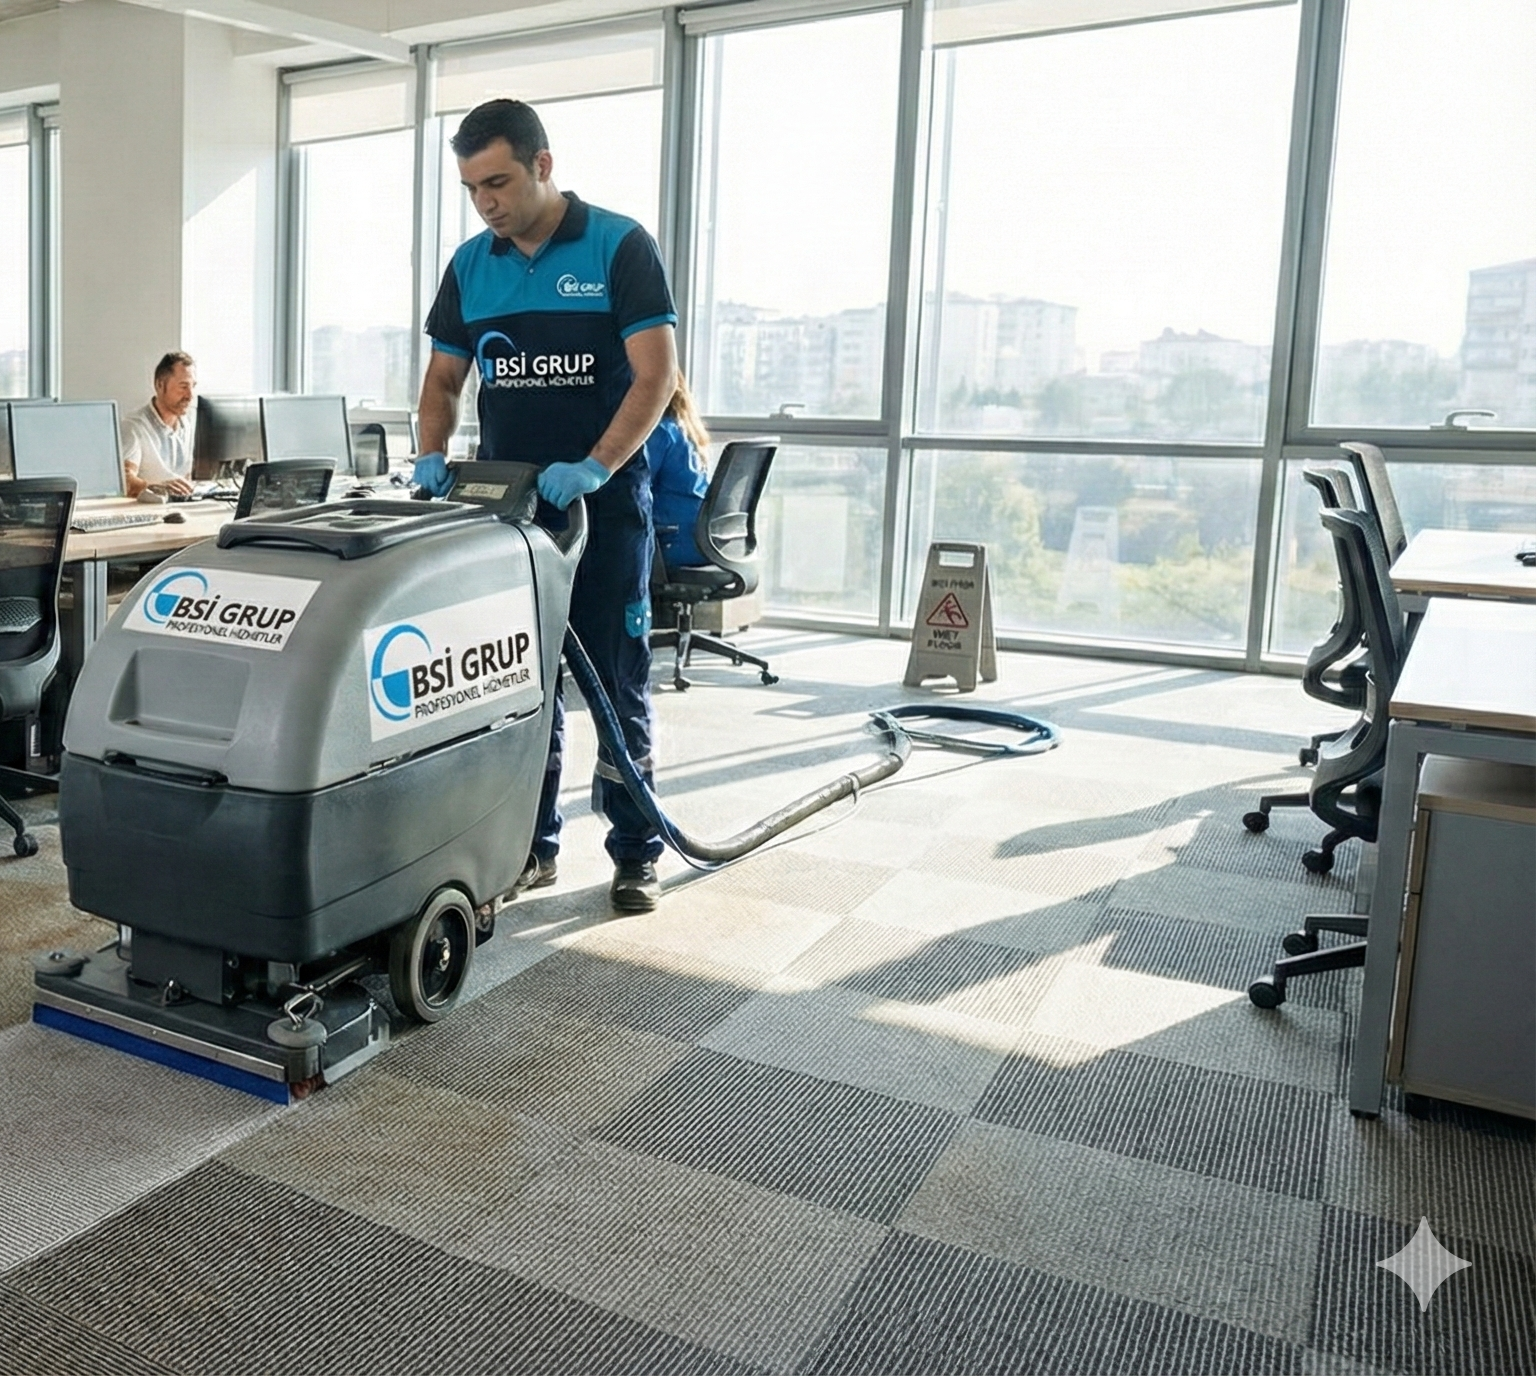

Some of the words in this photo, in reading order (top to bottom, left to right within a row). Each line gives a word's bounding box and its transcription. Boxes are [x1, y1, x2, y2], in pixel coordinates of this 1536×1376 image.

[495, 351, 526, 377] BSİ
[532, 353, 595, 375] GRUP
[172, 594, 221, 621] BSİ
[220, 603, 296, 629] GRUP
[412, 646, 454, 699] BSİ
[461, 632, 529, 681] GRUP
